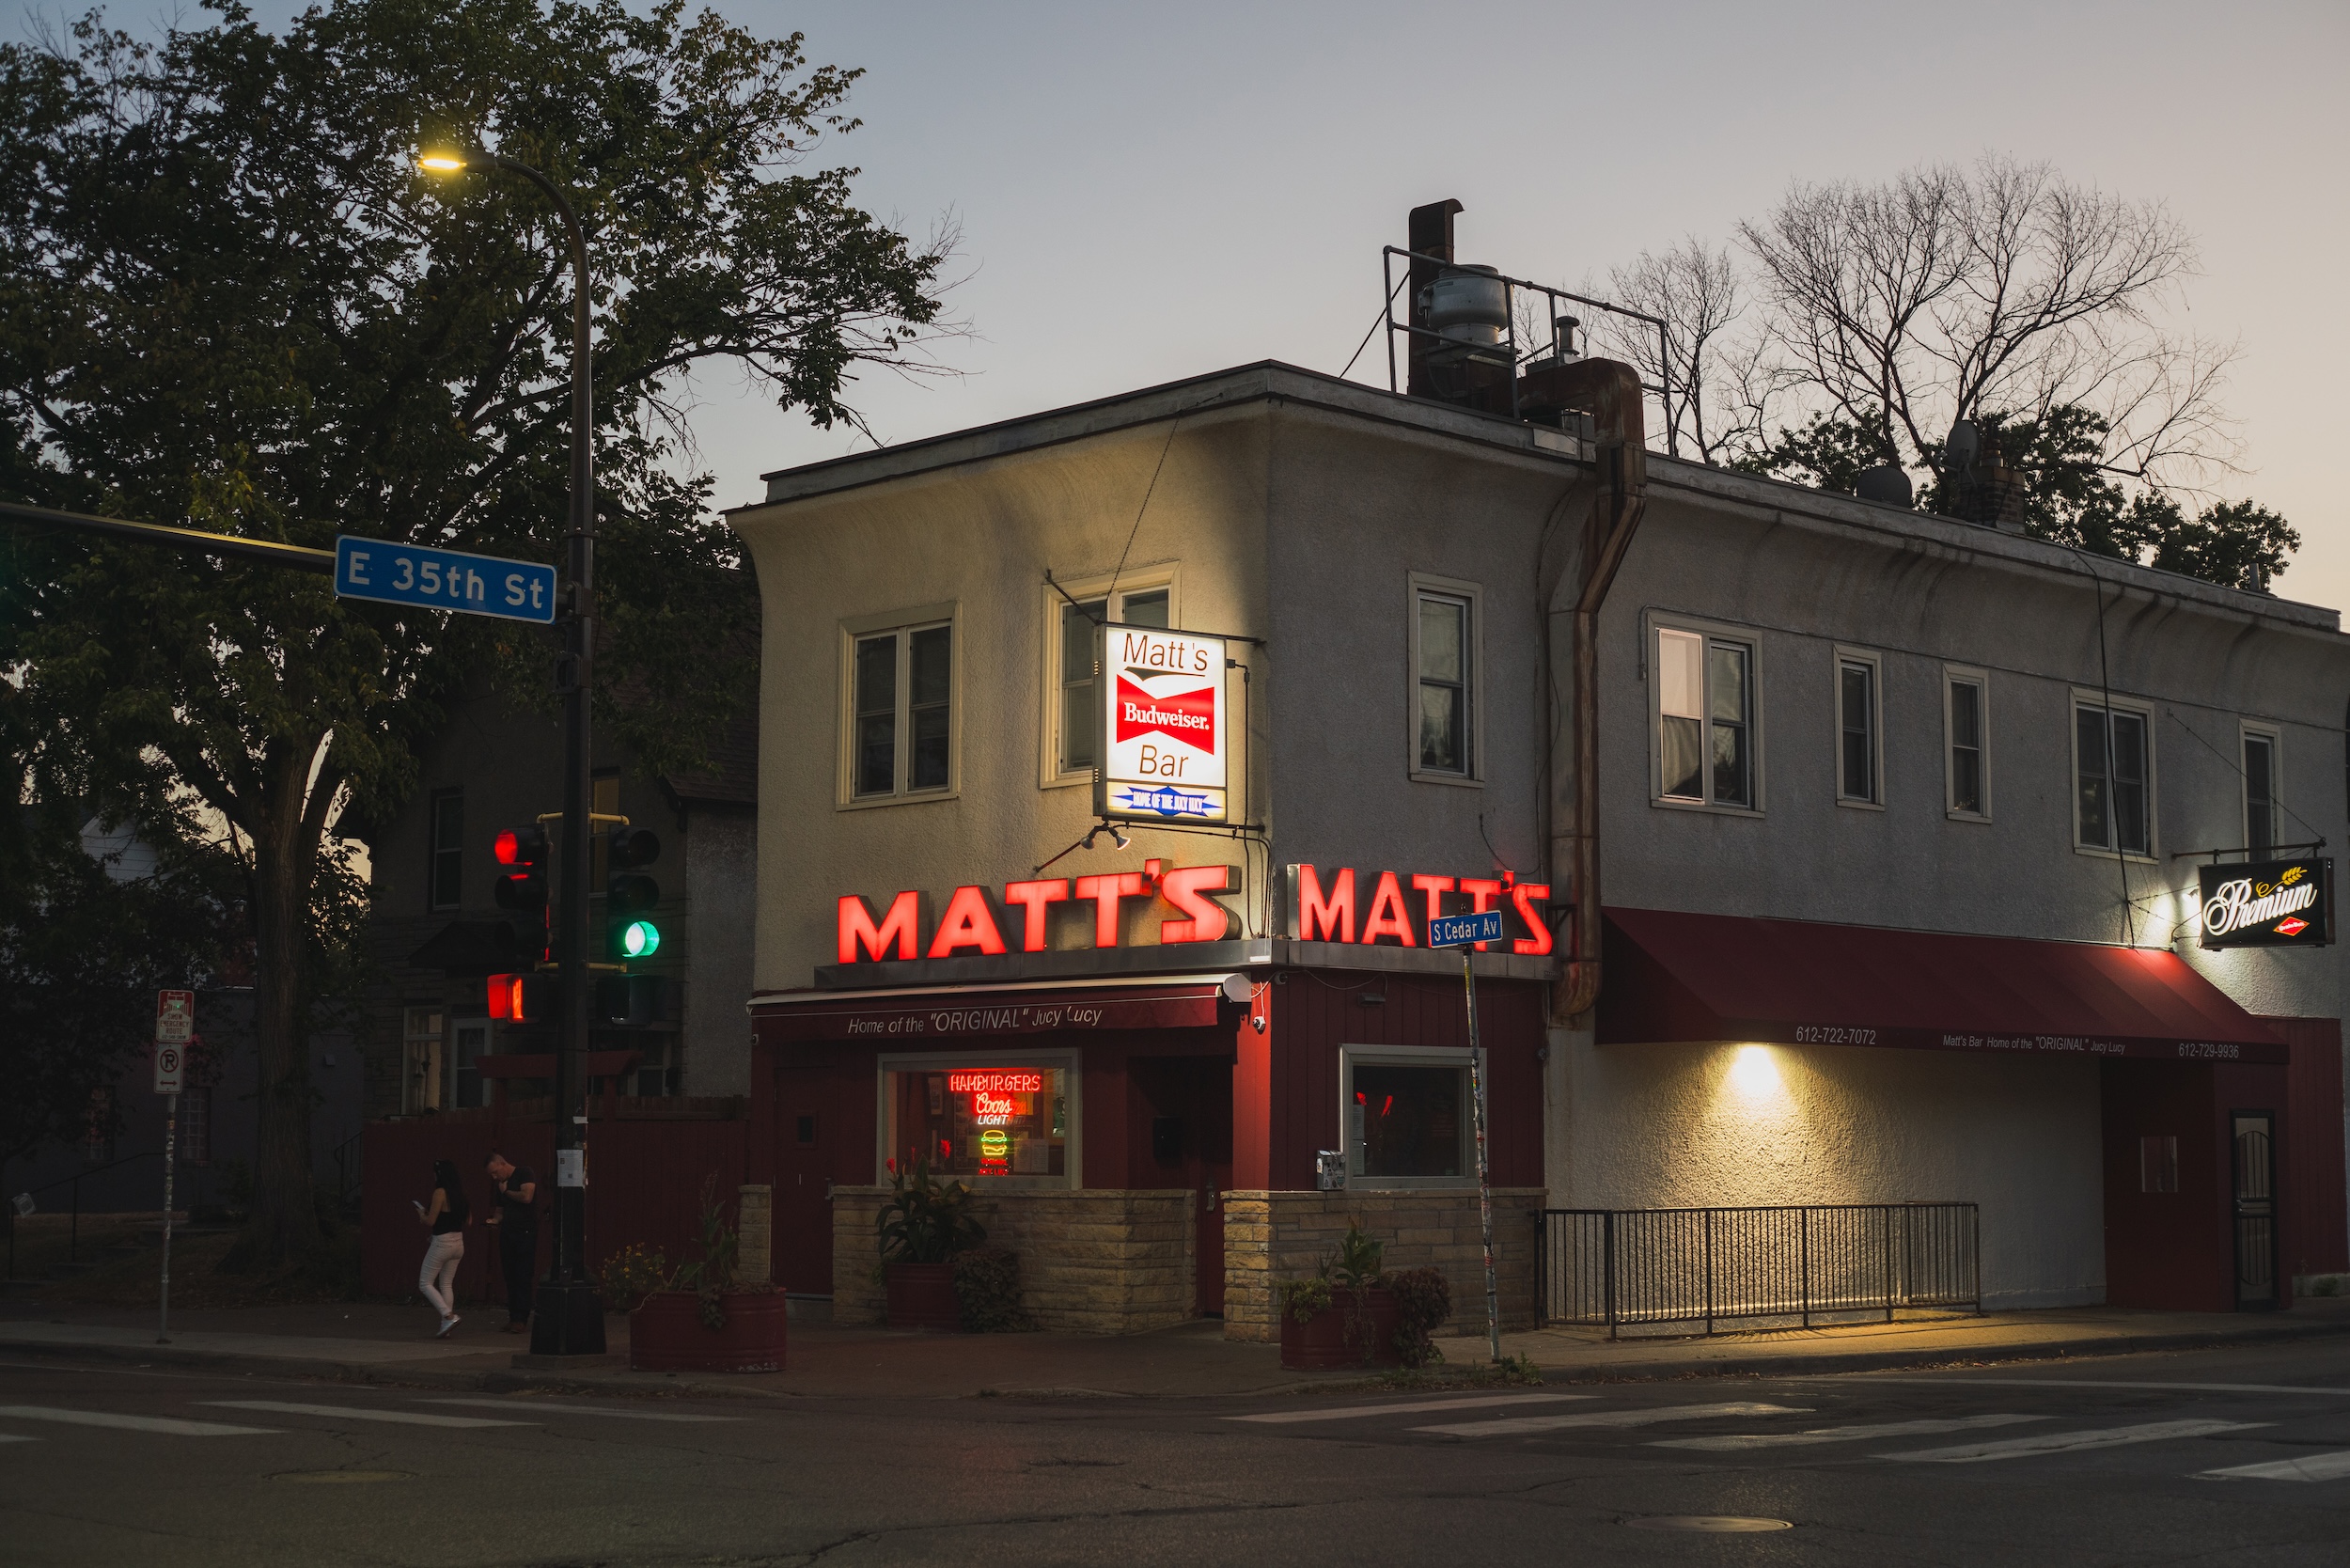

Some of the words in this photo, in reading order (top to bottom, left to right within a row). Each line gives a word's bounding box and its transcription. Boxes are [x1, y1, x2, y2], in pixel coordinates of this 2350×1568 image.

[349, 551, 370, 586] E
[392, 557, 485, 602] 35th
[505, 573, 543, 609] St
[1123, 633, 1209, 672] Matt's
[1139, 744, 1189, 777] Bar
[1133, 791, 1152, 808] HOME
[1152, 792, 1161, 808] OF
[838, 858, 1233, 964] MATT'S
[1299, 862, 1553, 956] MATT'S
[2202, 877, 2318, 936] Premium
[1434, 923, 1441, 942] S
[1445, 921, 1477, 940] Cedar
[1483, 917, 1497, 936] Av
[848, 1018, 885, 1034] Home
[888, 1017, 905, 1033] of
[905, 1017, 925, 1033] the
[1032, 1009, 1063, 1027] Jucy
[1066, 1006, 1103, 1027] Lucy
[1795, 1026, 1876, 1045] 612-722-7072
[1943, 1035, 1967, 1046] Matt's
[1968, 1036, 1982, 1047] Bar
[1987, 1037, 2010, 1048] Home
[2012, 1038, 2020, 1049] of
[2021, 1038, 2032, 1049] the
[2091, 1042, 2107, 1054] Jucy
[2108, 1042, 2125, 1055] Lucy
[2179, 1043, 2240, 1058] 612-729-9936
[950, 1074, 1041, 1091] HAMBURGERS
[976, 1092, 1012, 1114] Coors
[978, 1114, 1009, 1125] LIGHT
